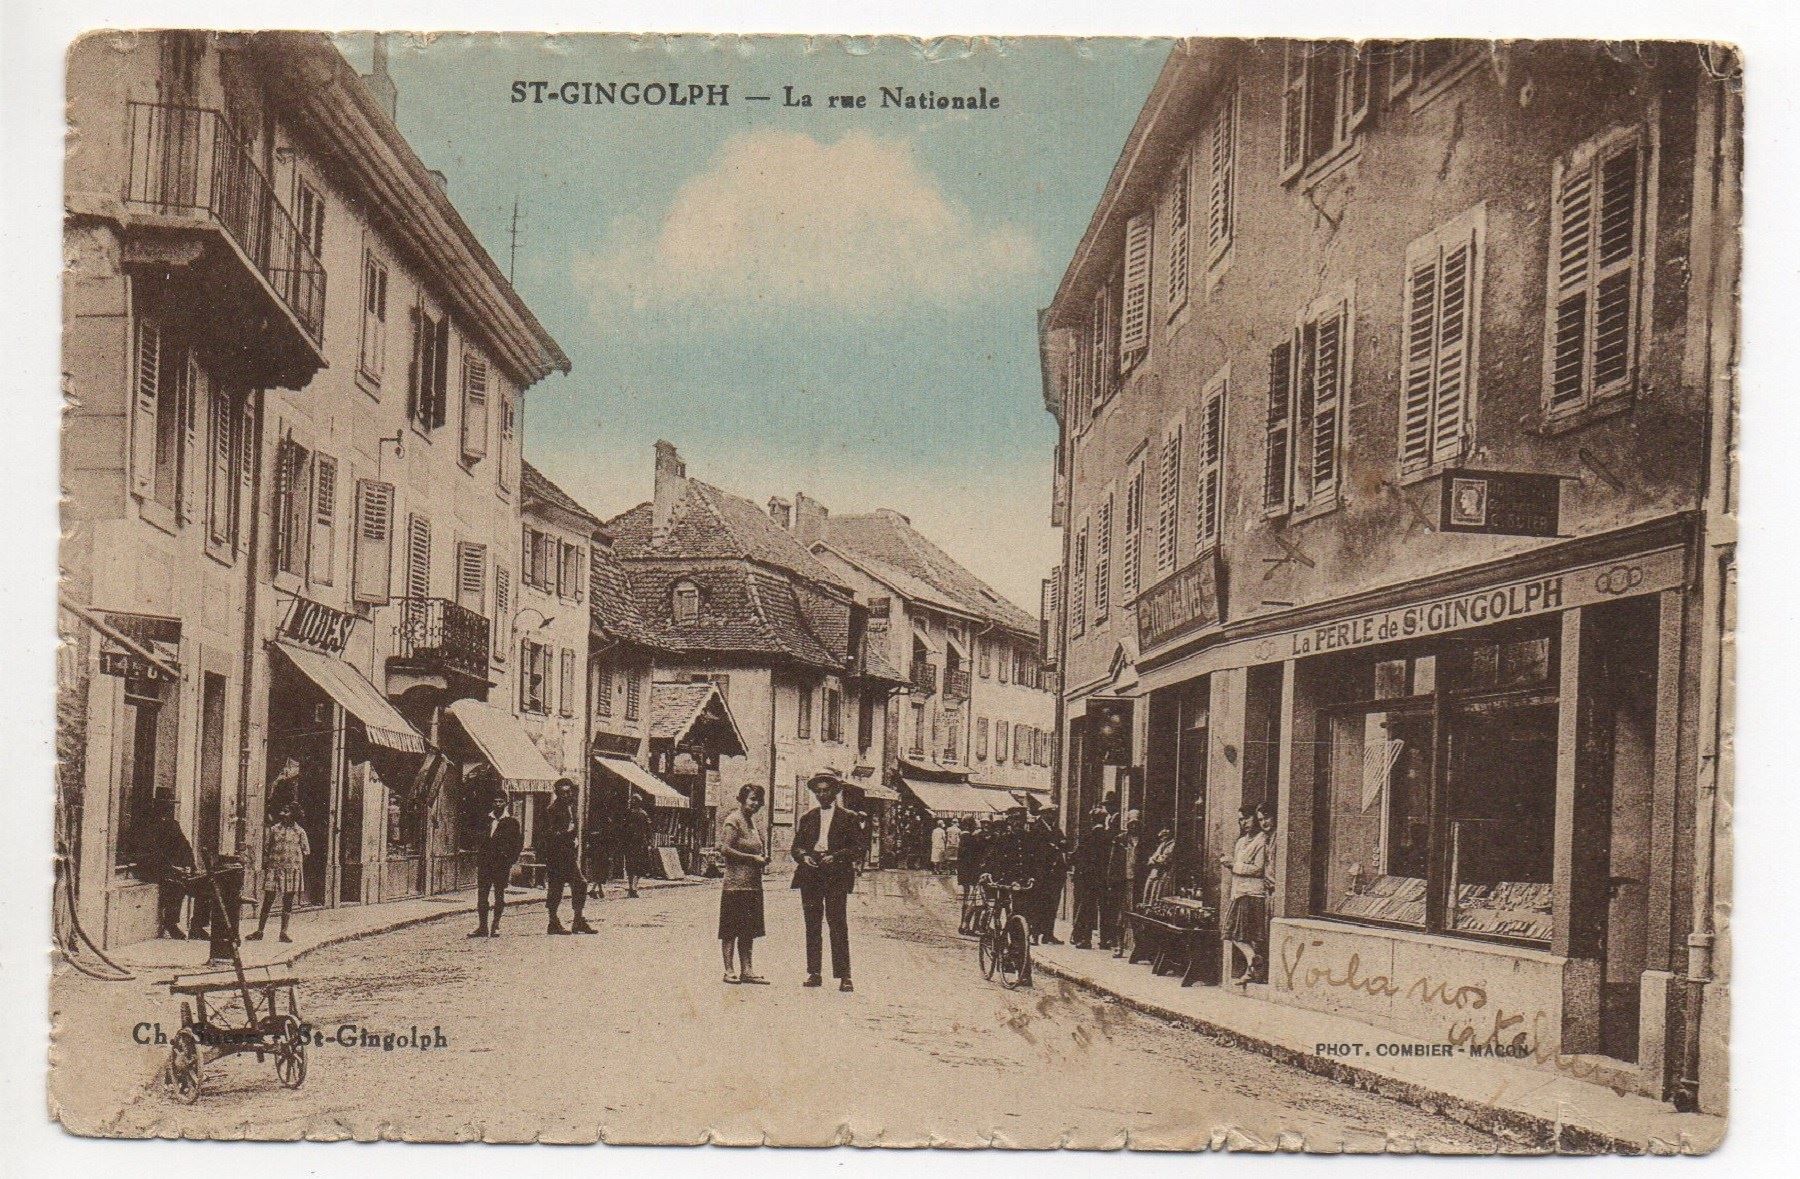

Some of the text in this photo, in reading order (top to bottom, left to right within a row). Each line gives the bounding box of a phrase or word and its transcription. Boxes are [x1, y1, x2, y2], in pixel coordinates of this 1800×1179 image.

[1292, 633, 1310, 656] La
[1314, 617, 1374, 651] PERLE
[1377, 613, 1398, 641] de
[1427, 576, 1563, 632] GINGOLPH
